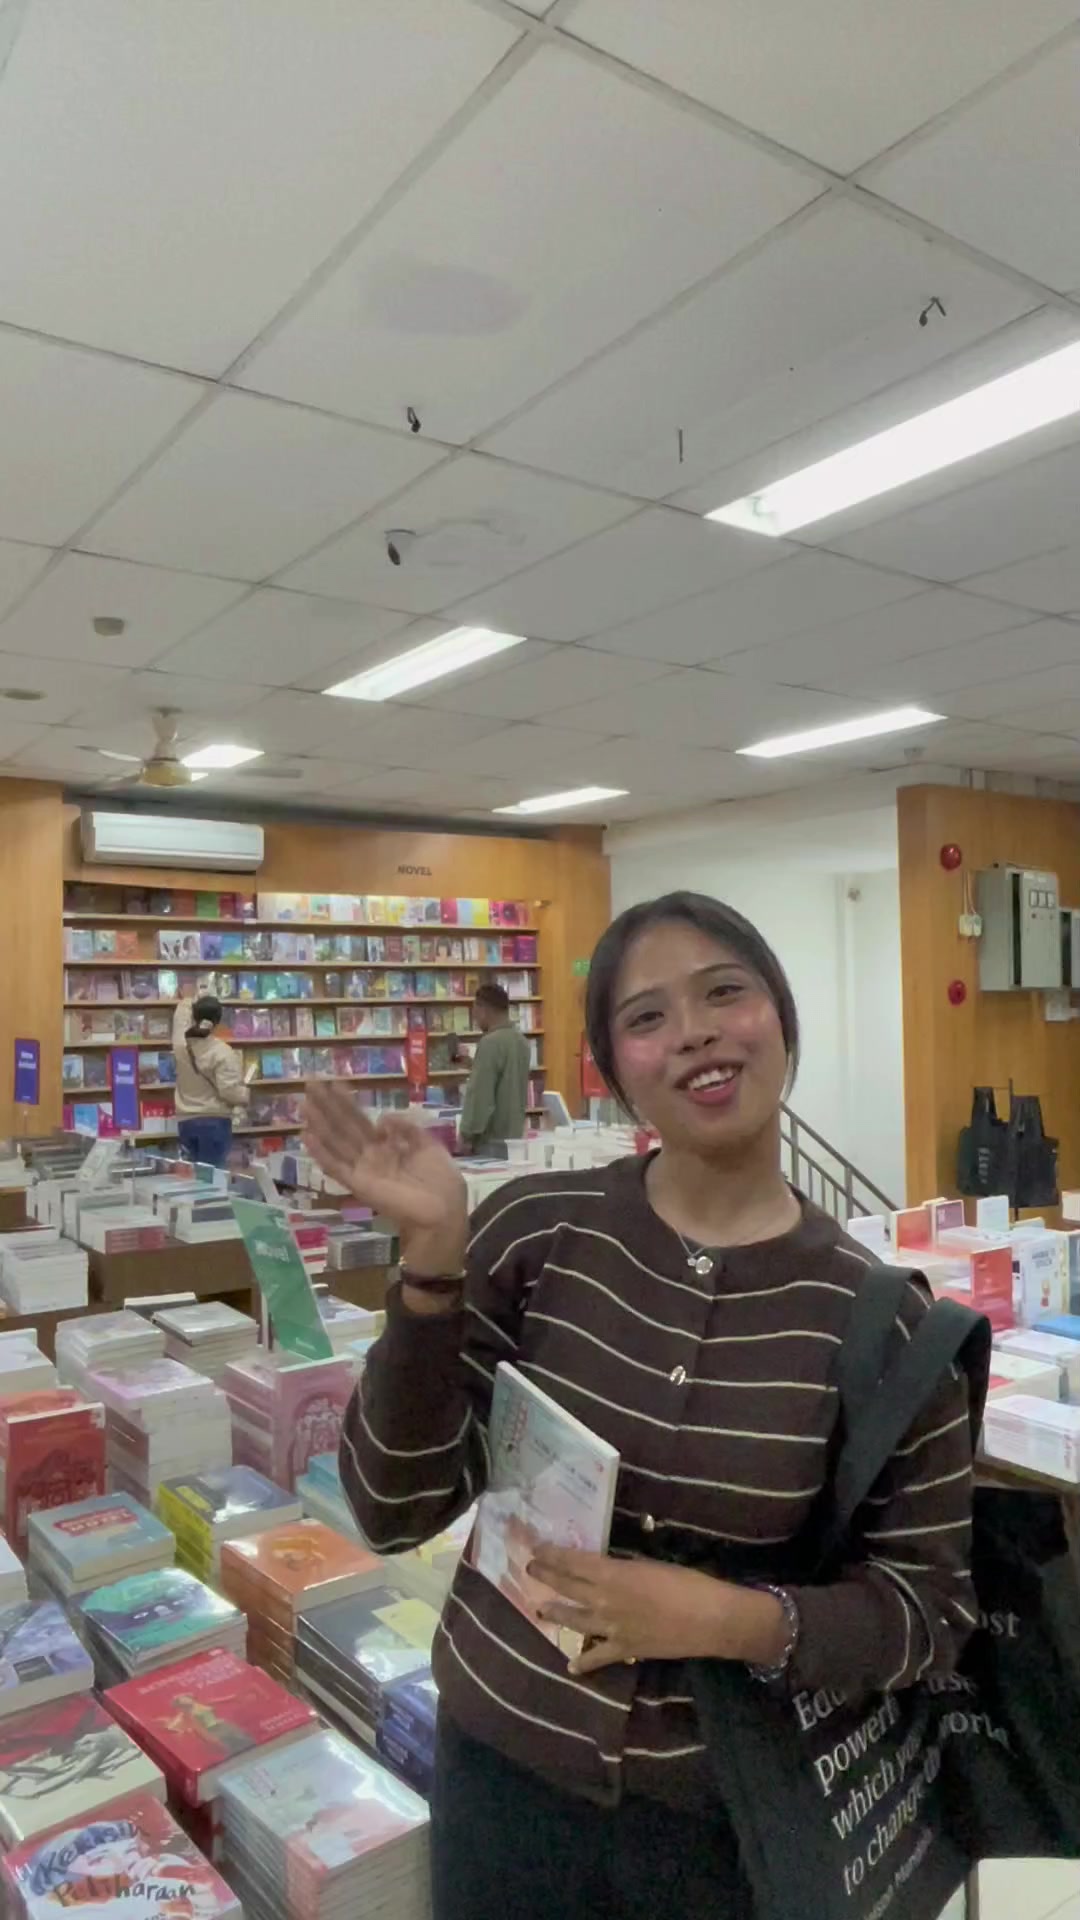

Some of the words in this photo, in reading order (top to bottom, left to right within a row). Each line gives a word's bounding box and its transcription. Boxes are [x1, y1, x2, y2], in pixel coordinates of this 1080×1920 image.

[397, 864, 433, 877] NOVEL
[831, 1757, 896, 1841] which
[844, 1856, 865, 1896] to
